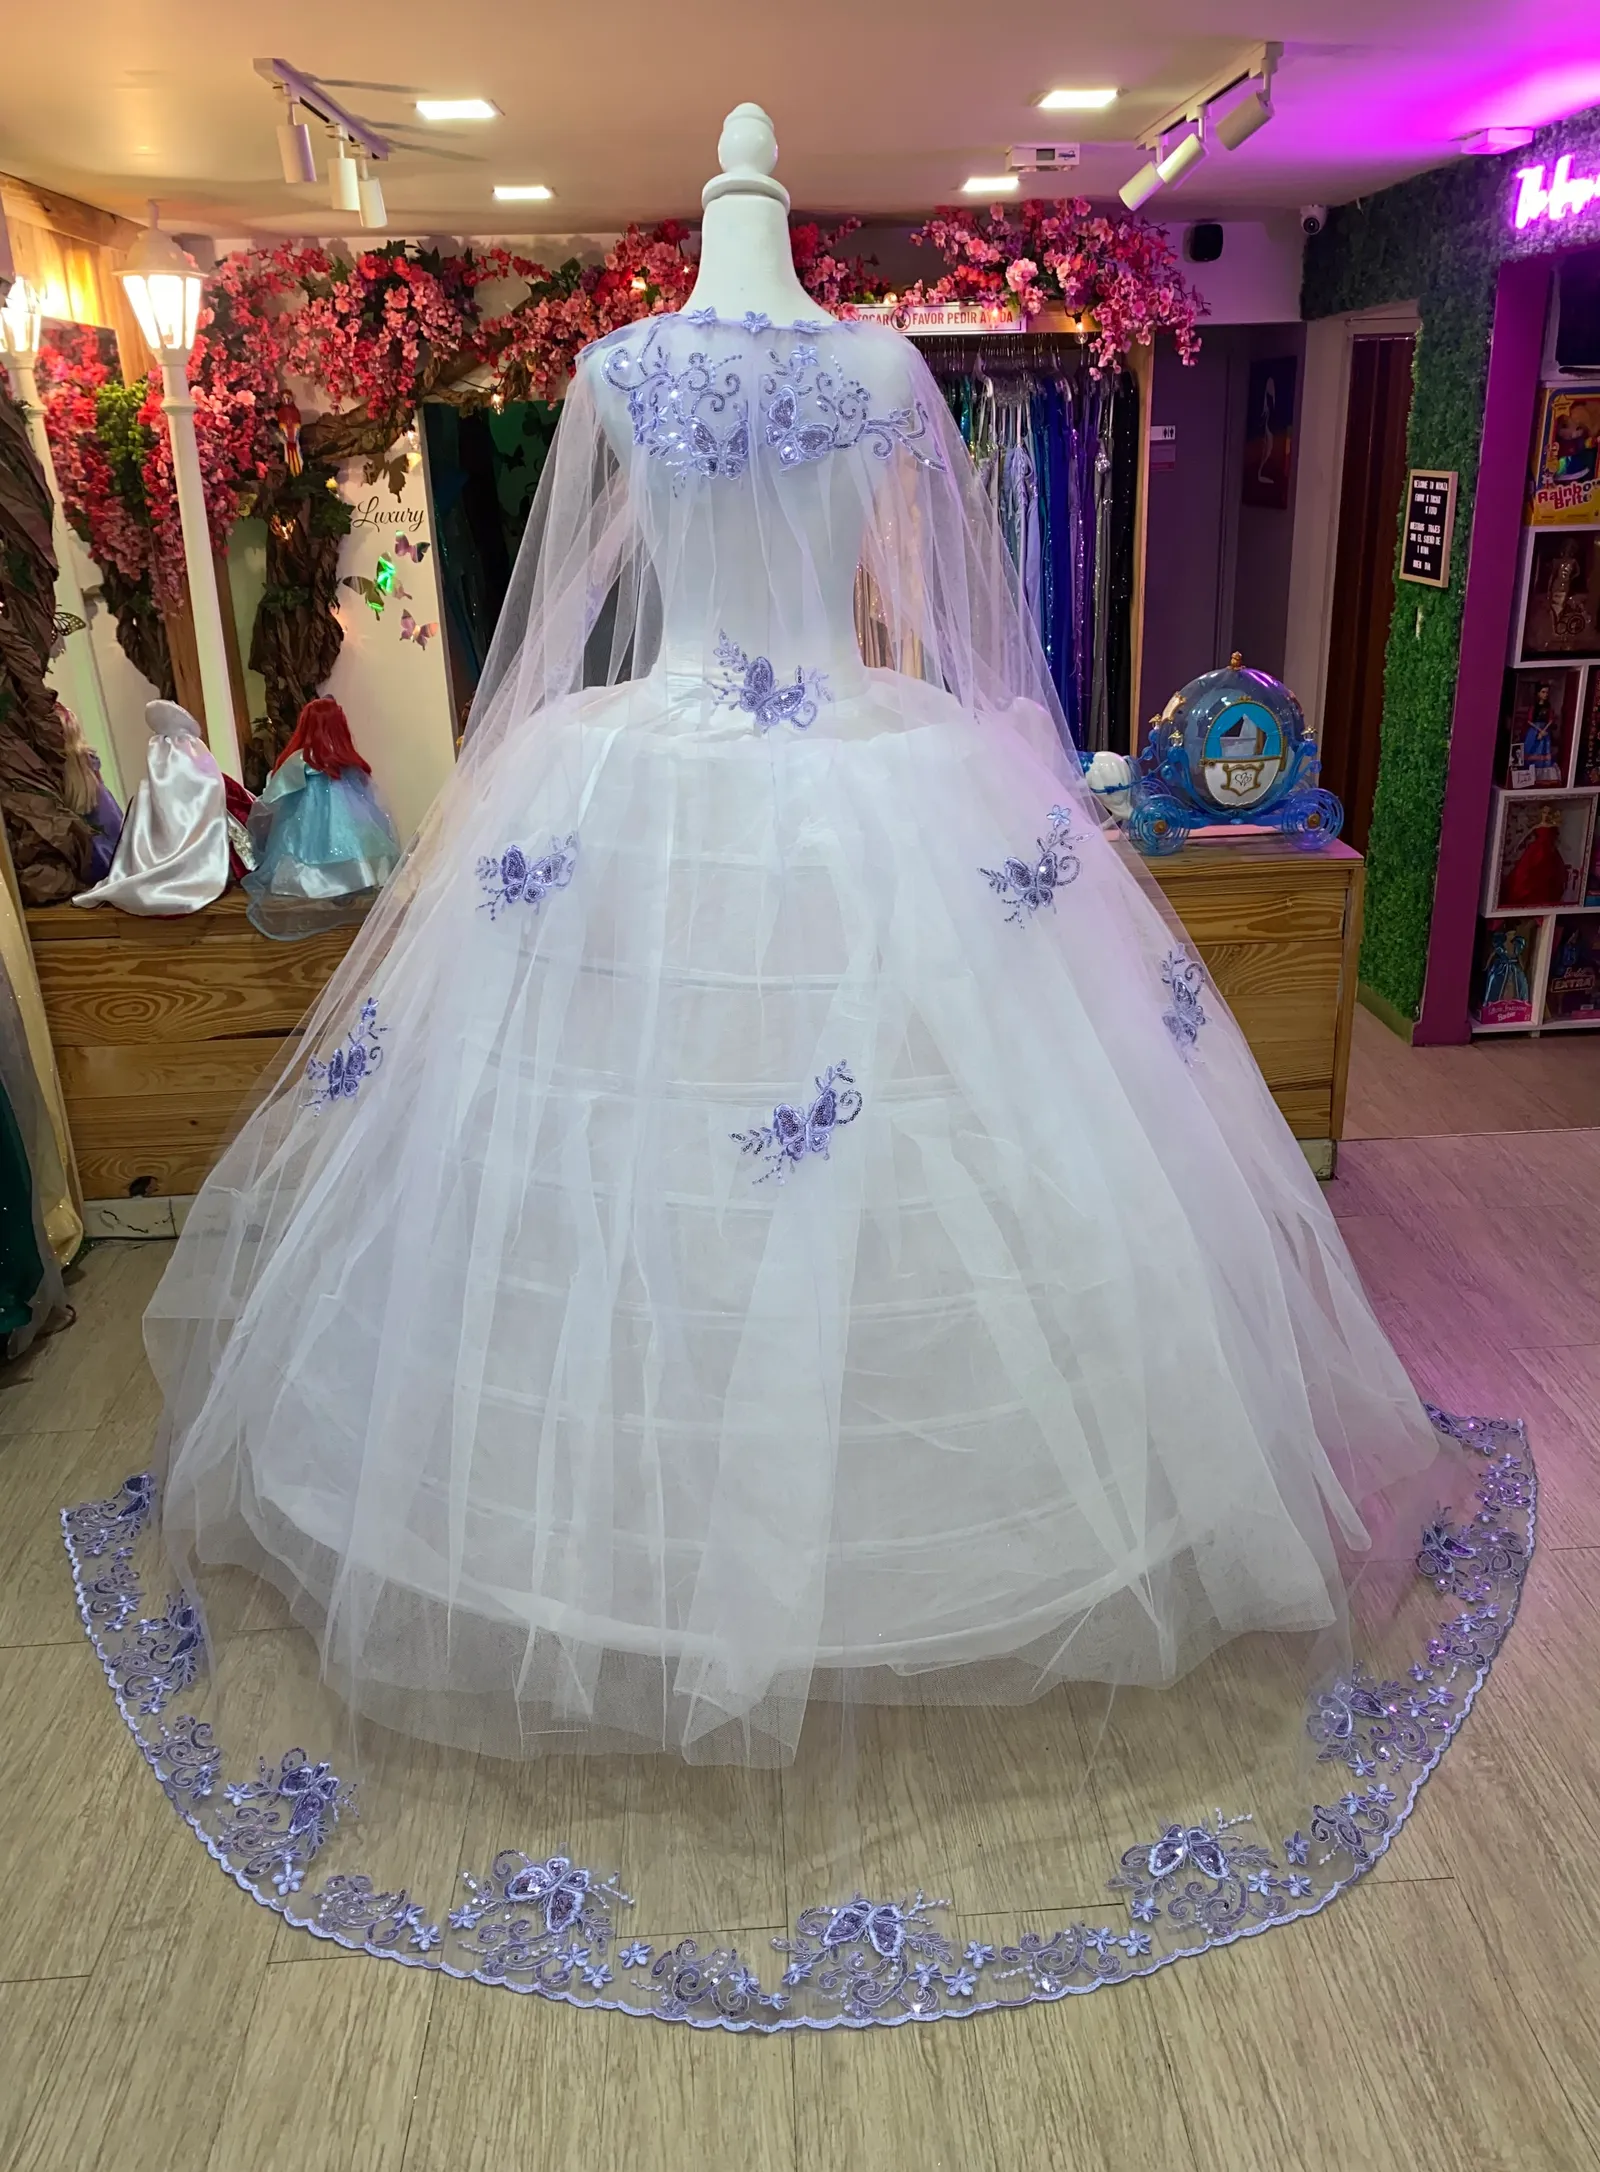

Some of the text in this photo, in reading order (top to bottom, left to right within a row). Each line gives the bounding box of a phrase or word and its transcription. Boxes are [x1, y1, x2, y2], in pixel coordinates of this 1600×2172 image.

[912, 312, 945, 325] FAVOR
[947, 311, 977, 324] PEDIR
[980, 311, 1013, 323] AYDA
[352, 496, 424, 533] Luxury
